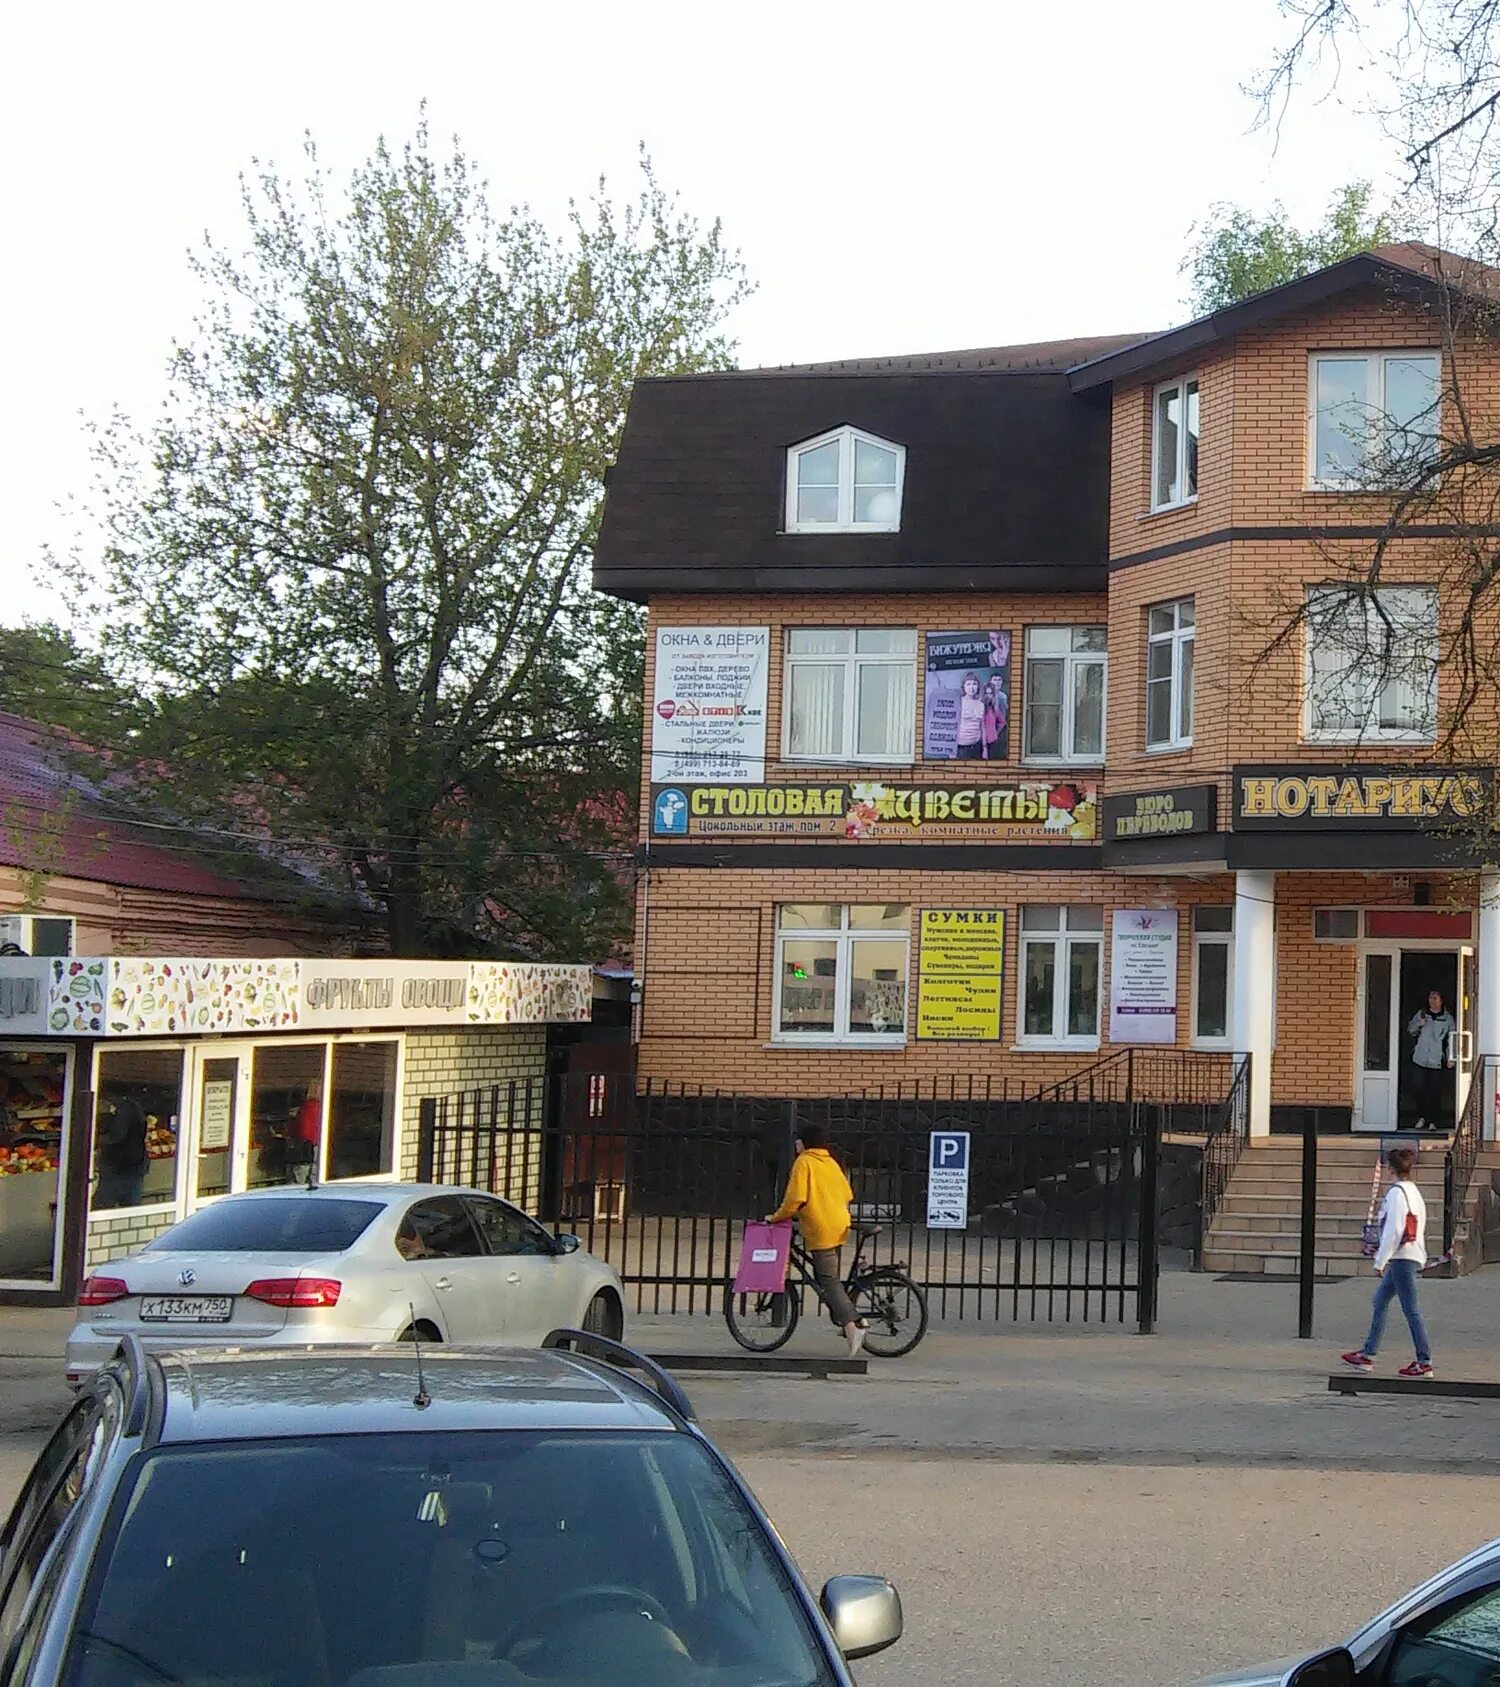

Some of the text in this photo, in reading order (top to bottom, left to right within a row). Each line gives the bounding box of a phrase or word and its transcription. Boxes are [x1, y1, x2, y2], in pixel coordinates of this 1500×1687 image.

[661, 634, 765, 648] ОКНА & ДВЕРИ
[691, 788, 844, 815] СТОЛОВАЯ
[894, 790, 1048, 826] ЦВЕТЫ
[1136, 794, 1174, 815] БЮРО
[1241, 776, 1484, 817] НОТАРИУС
[698, 820, 763, 832] Цокольный
[830, 821, 836, 831] 2
[921, 826, 999, 835] комнатные
[1007, 826, 1068, 837] растения
[1116, 810, 1194, 836] ПЕРЕВОДОВ
[928, 912, 998, 923] СУМКИ
[307, 978, 467, 1011] ФРУКТЫ ОВОЩИ
[940, 1139, 959, 1165] P
[205, 1299, 226, 1311] 750
